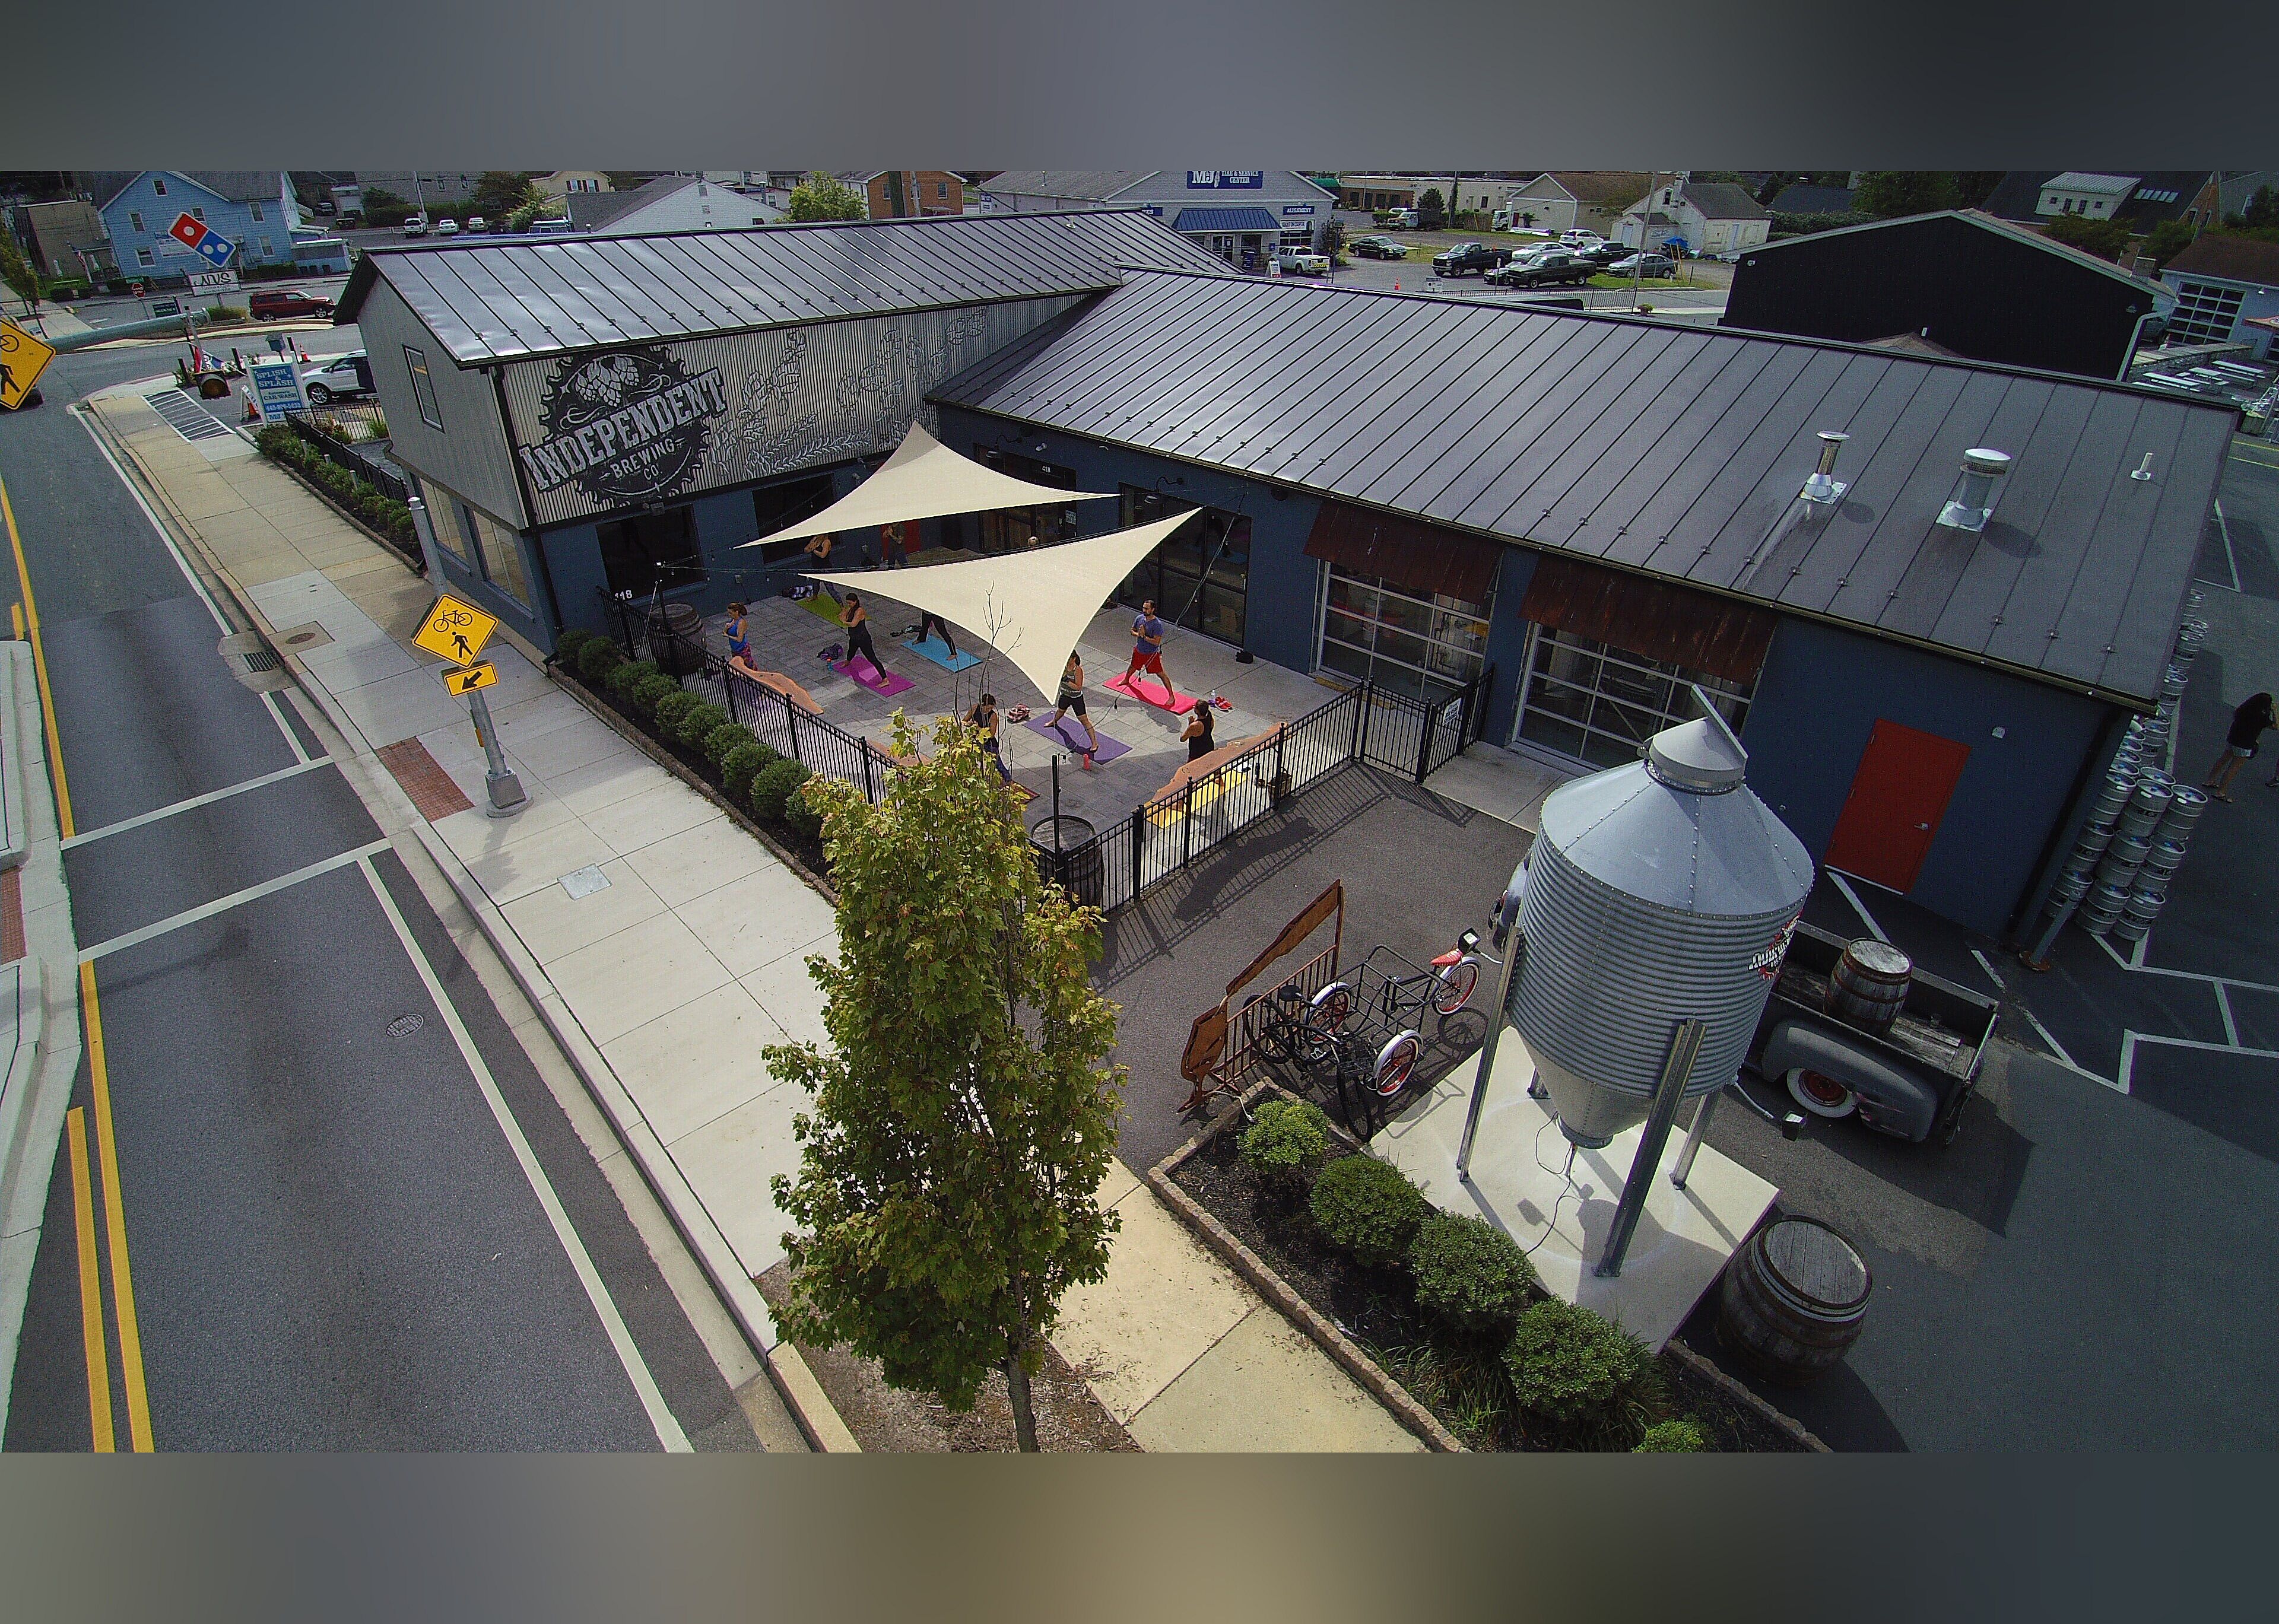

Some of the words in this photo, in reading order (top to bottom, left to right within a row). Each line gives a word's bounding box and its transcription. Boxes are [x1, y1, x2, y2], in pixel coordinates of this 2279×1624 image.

[256, 368, 287, 379] SPLISH
[519, 368, 726, 491] INDEPENDENT
[610, 438, 675, 478] BREWING
[643, 464, 663, 480] CO.
